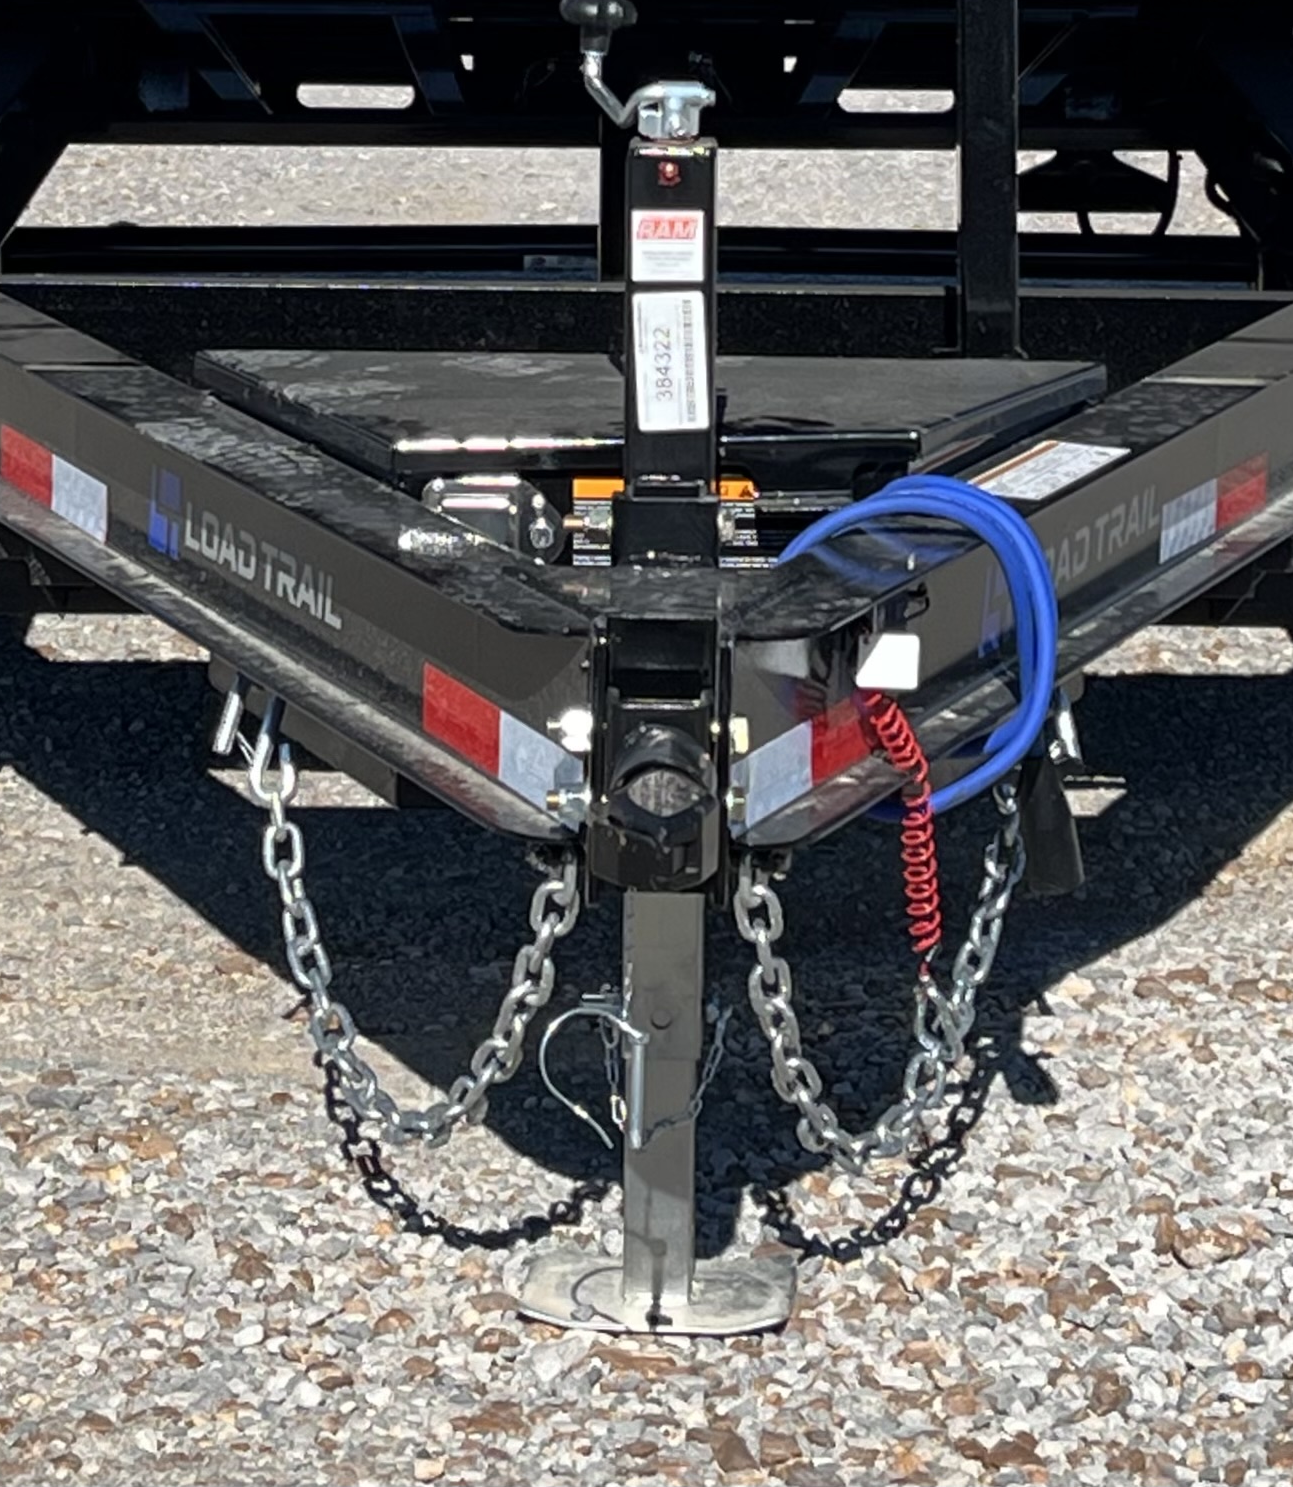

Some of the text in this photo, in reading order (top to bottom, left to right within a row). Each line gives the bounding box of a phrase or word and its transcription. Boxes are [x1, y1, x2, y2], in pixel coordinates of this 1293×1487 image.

[636, 217, 699, 241] RAM
[652, 327, 674, 403] 384322
[1094, 484, 1160, 563] TRAIL
[184, 501, 343, 631] LOAD TRAIL
